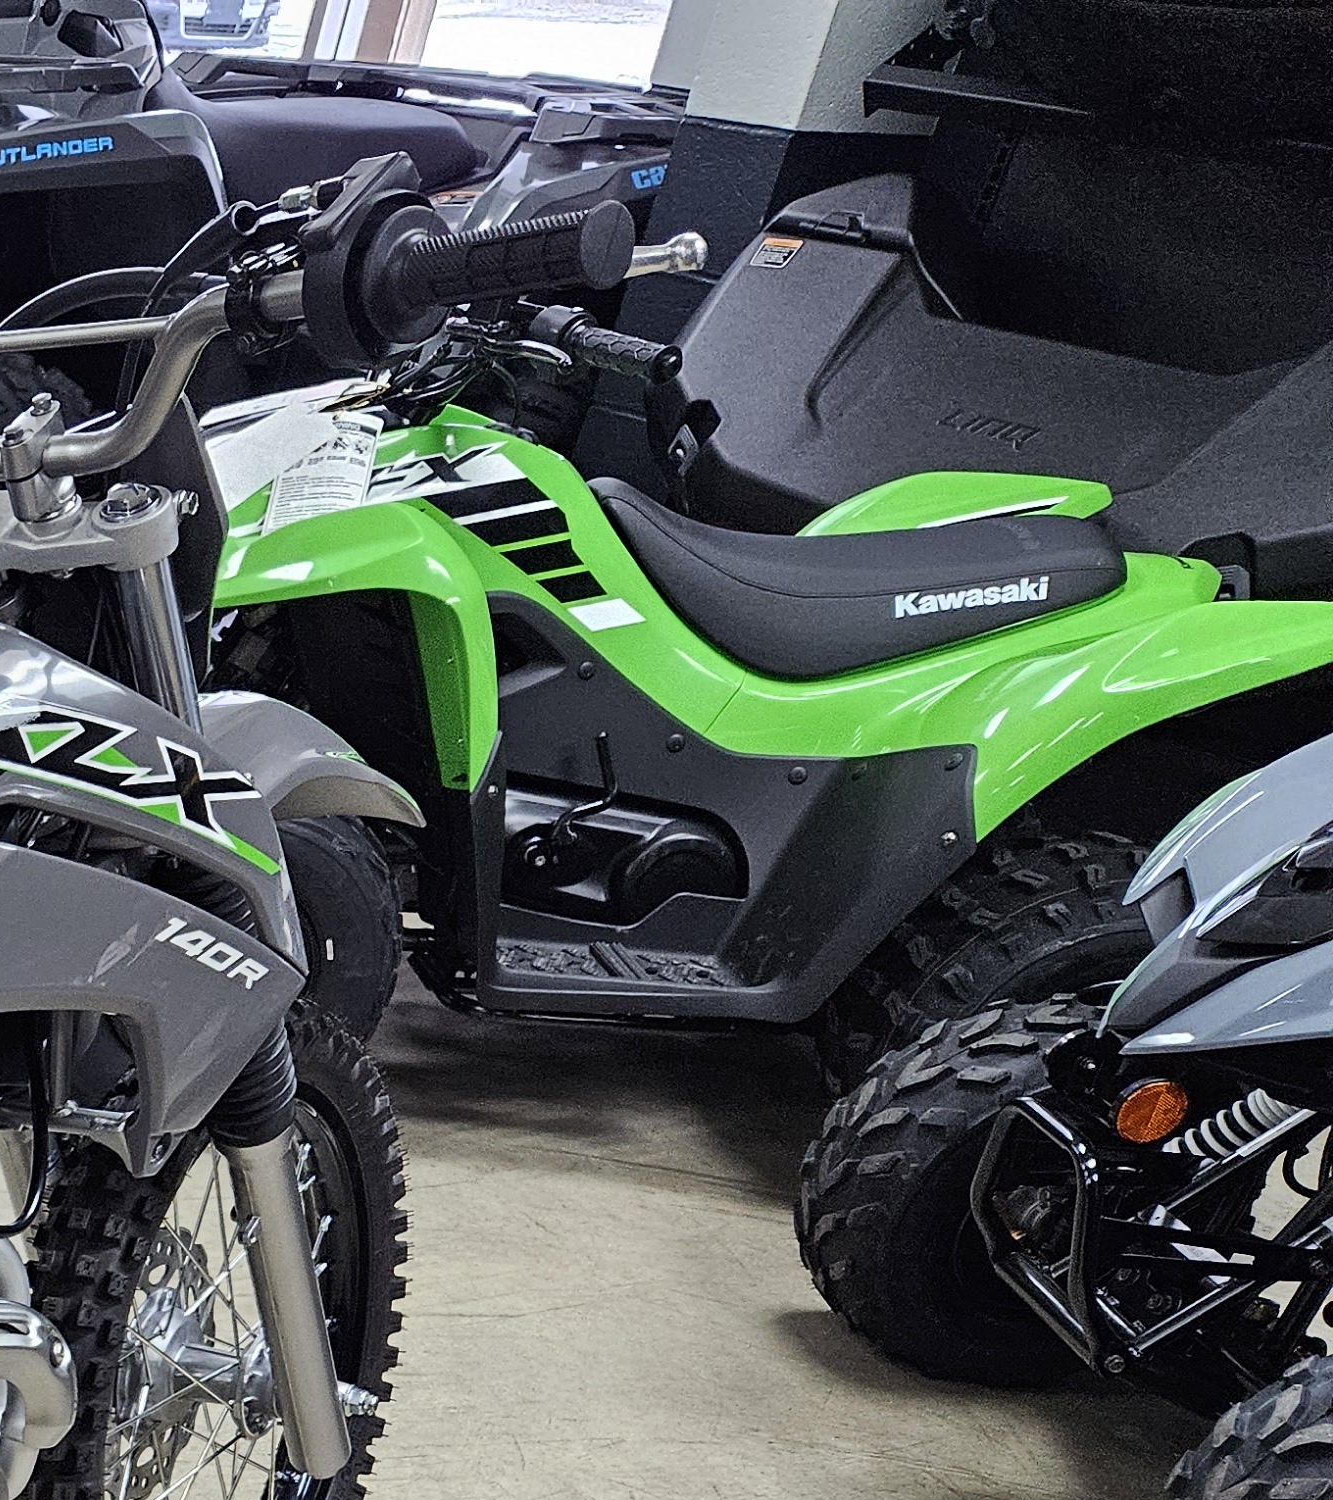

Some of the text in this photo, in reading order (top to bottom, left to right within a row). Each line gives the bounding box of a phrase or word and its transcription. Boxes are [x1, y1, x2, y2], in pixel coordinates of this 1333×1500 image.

[631, 164, 668, 190] ca
[367, 440, 507, 498] FX
[894, 577, 1050, 618] Kawasaki
[154, 917, 269, 990] 140R
